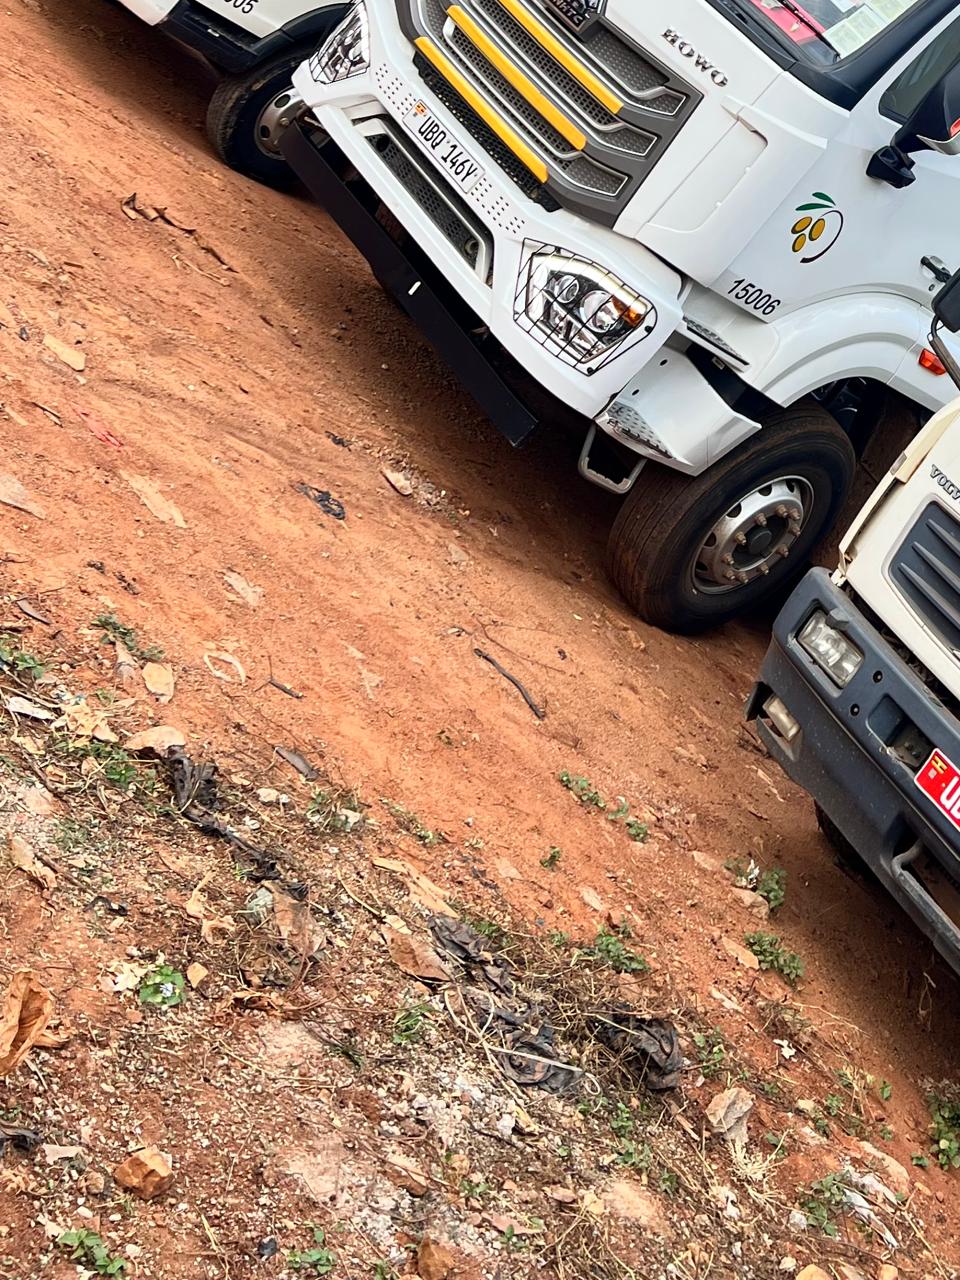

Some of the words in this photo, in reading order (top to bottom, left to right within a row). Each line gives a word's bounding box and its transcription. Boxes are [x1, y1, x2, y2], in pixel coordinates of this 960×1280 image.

[661, 28, 729, 87] HOWO
[418, 115, 447, 150] UBQ
[441, 144, 478, 182] 146Y
[727, 278, 781, 315] 15006
